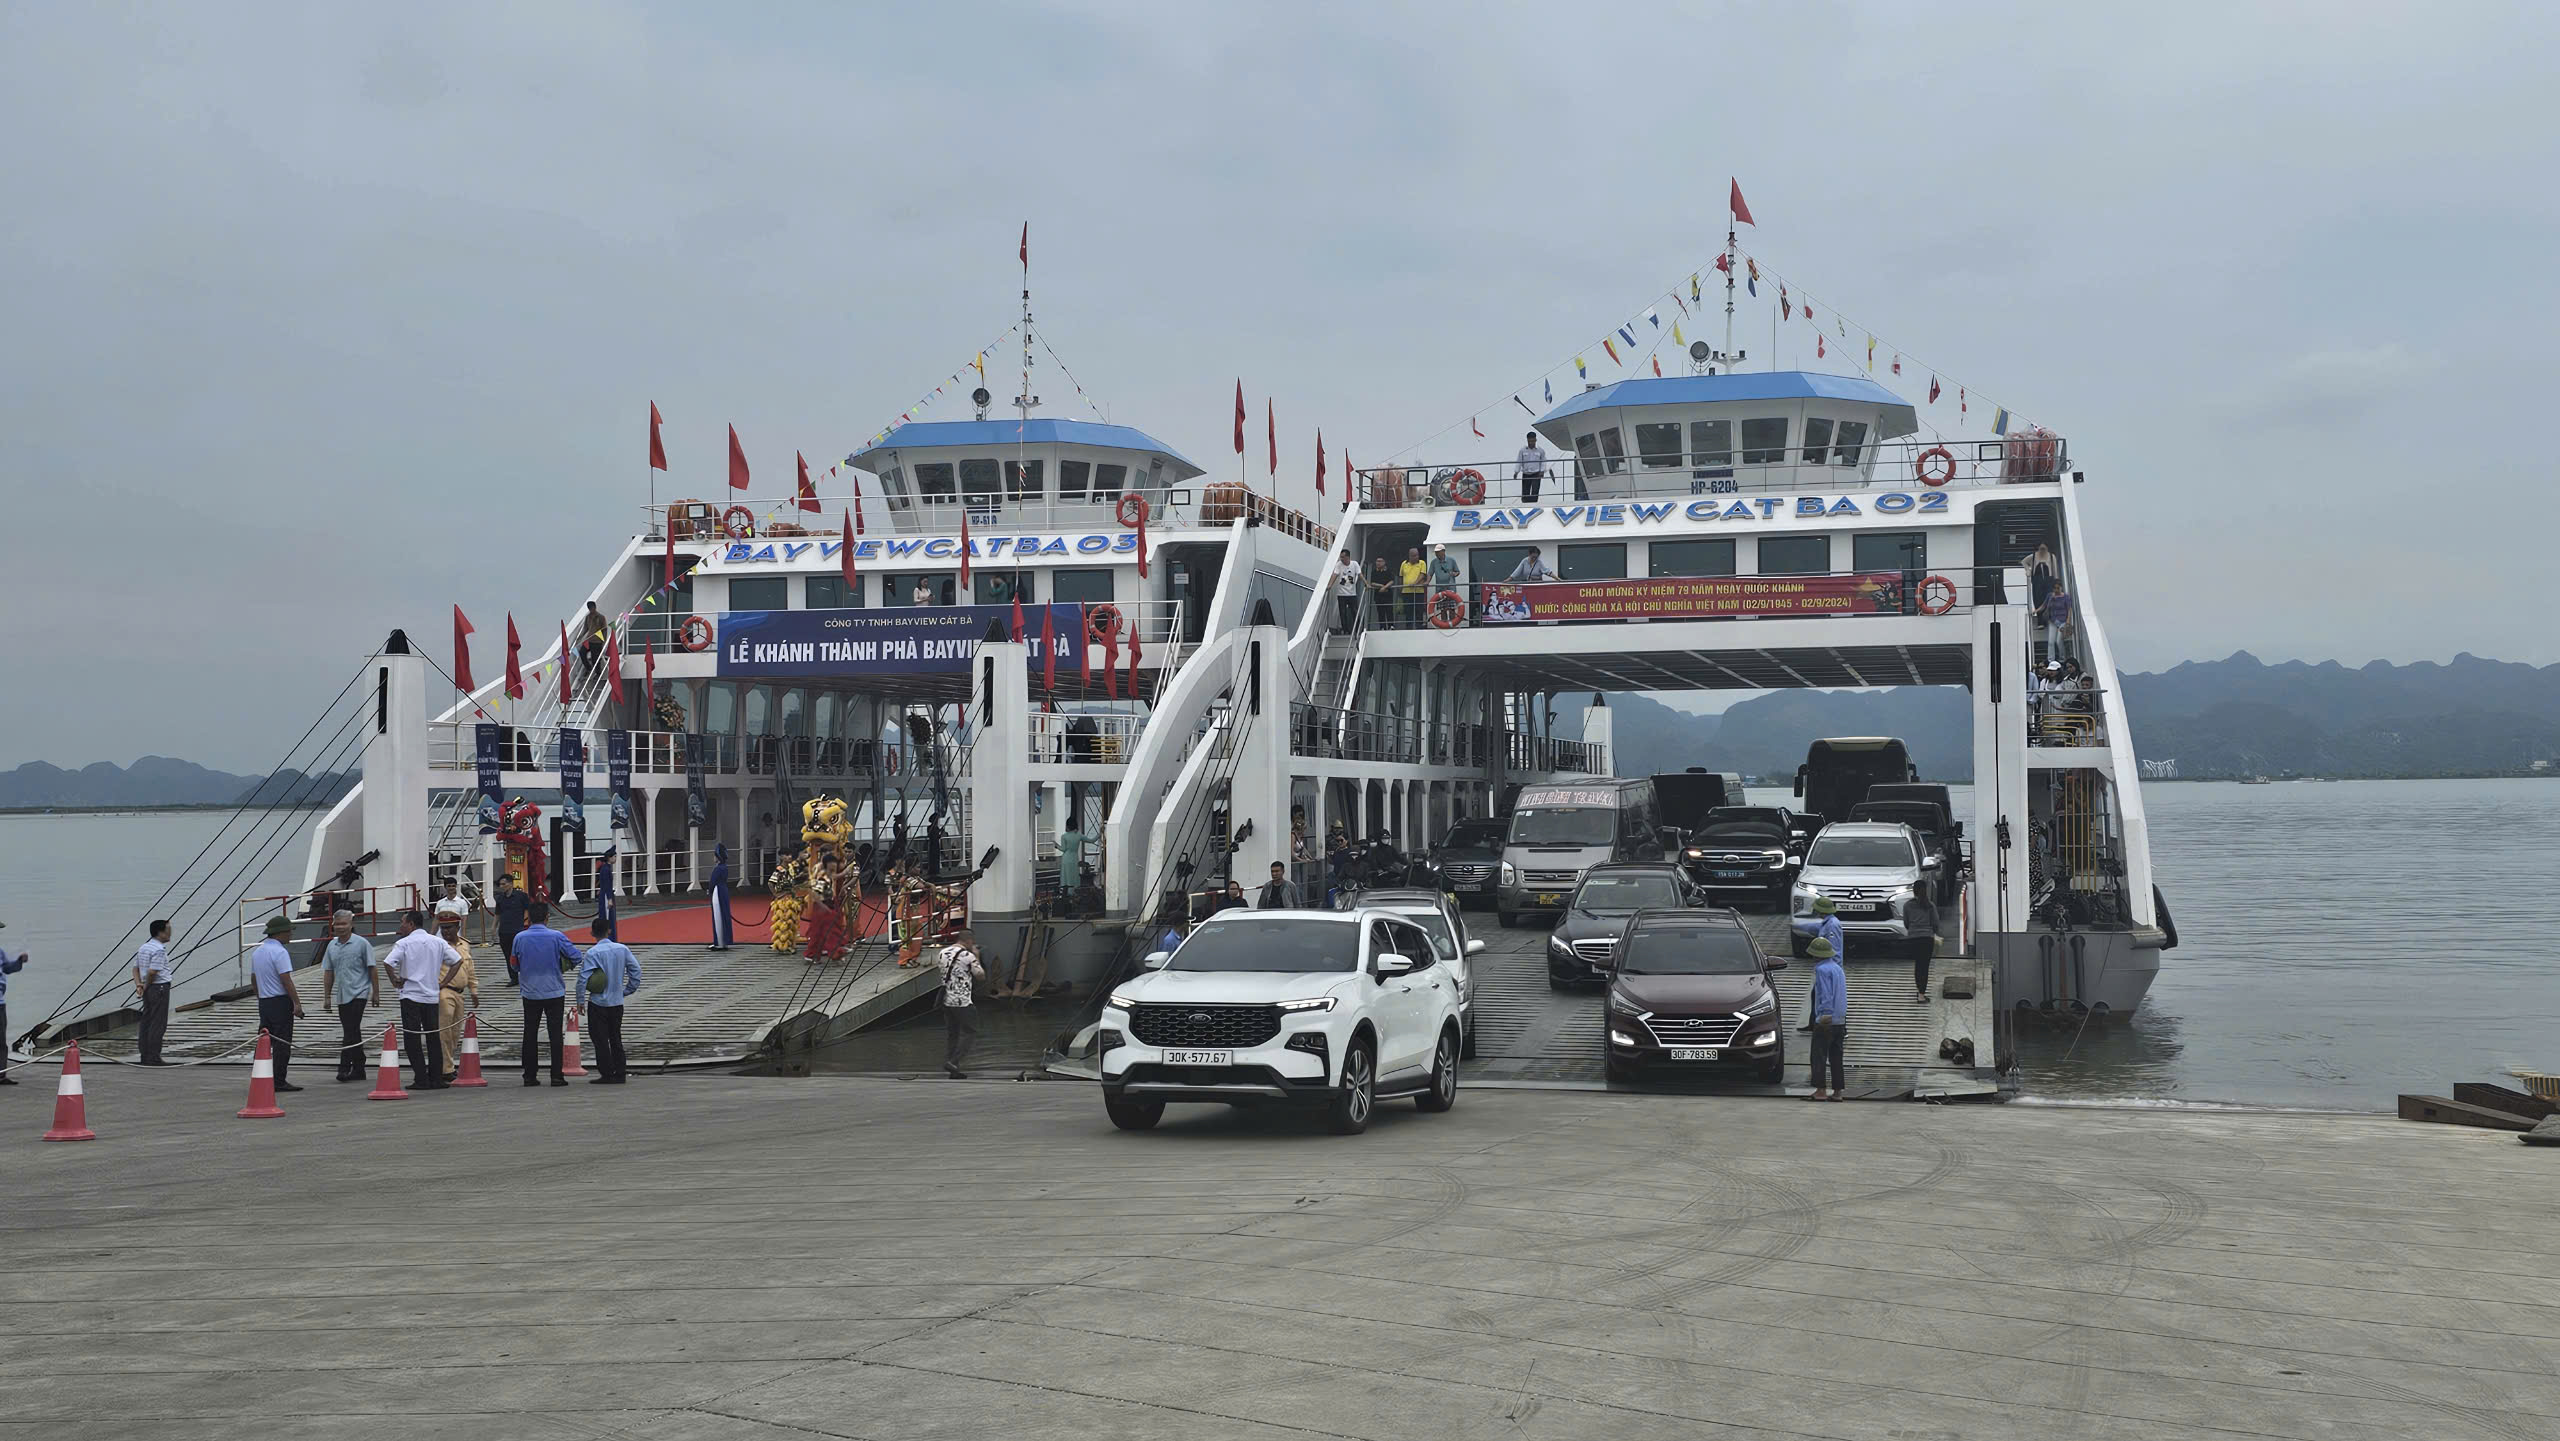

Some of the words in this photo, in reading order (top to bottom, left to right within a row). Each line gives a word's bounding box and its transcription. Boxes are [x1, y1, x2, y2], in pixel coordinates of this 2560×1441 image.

[1691, 480, 1738, 495] HP-6204
[1451, 507, 1544, 531] BAY
[1553, 503, 1678, 527] VIEW
[1686, 498, 1784, 521] CAT
[1796, 496, 1862, 518] BA
[1677, 585, 1689, 595] 79
[1717, 599, 1740, 610] NAM
[824, 617, 852, 628] CÔNG
[853, 619, 866, 627] TY
[868, 618, 893, 627] TNHH
[895, 617, 938, 626] BAYVIEW
[939, 615, 958, 625] CÁT
[960, 614, 973, 625] BÀ
[729, 637, 749, 663] LỄ
[754, 639, 814, 663] KHÁNH
[819, 638, 877, 661] THÀNH
[882, 636, 918, 661] PHÀ
[1168, 1052, 1226, 1064] 30K-577.67
